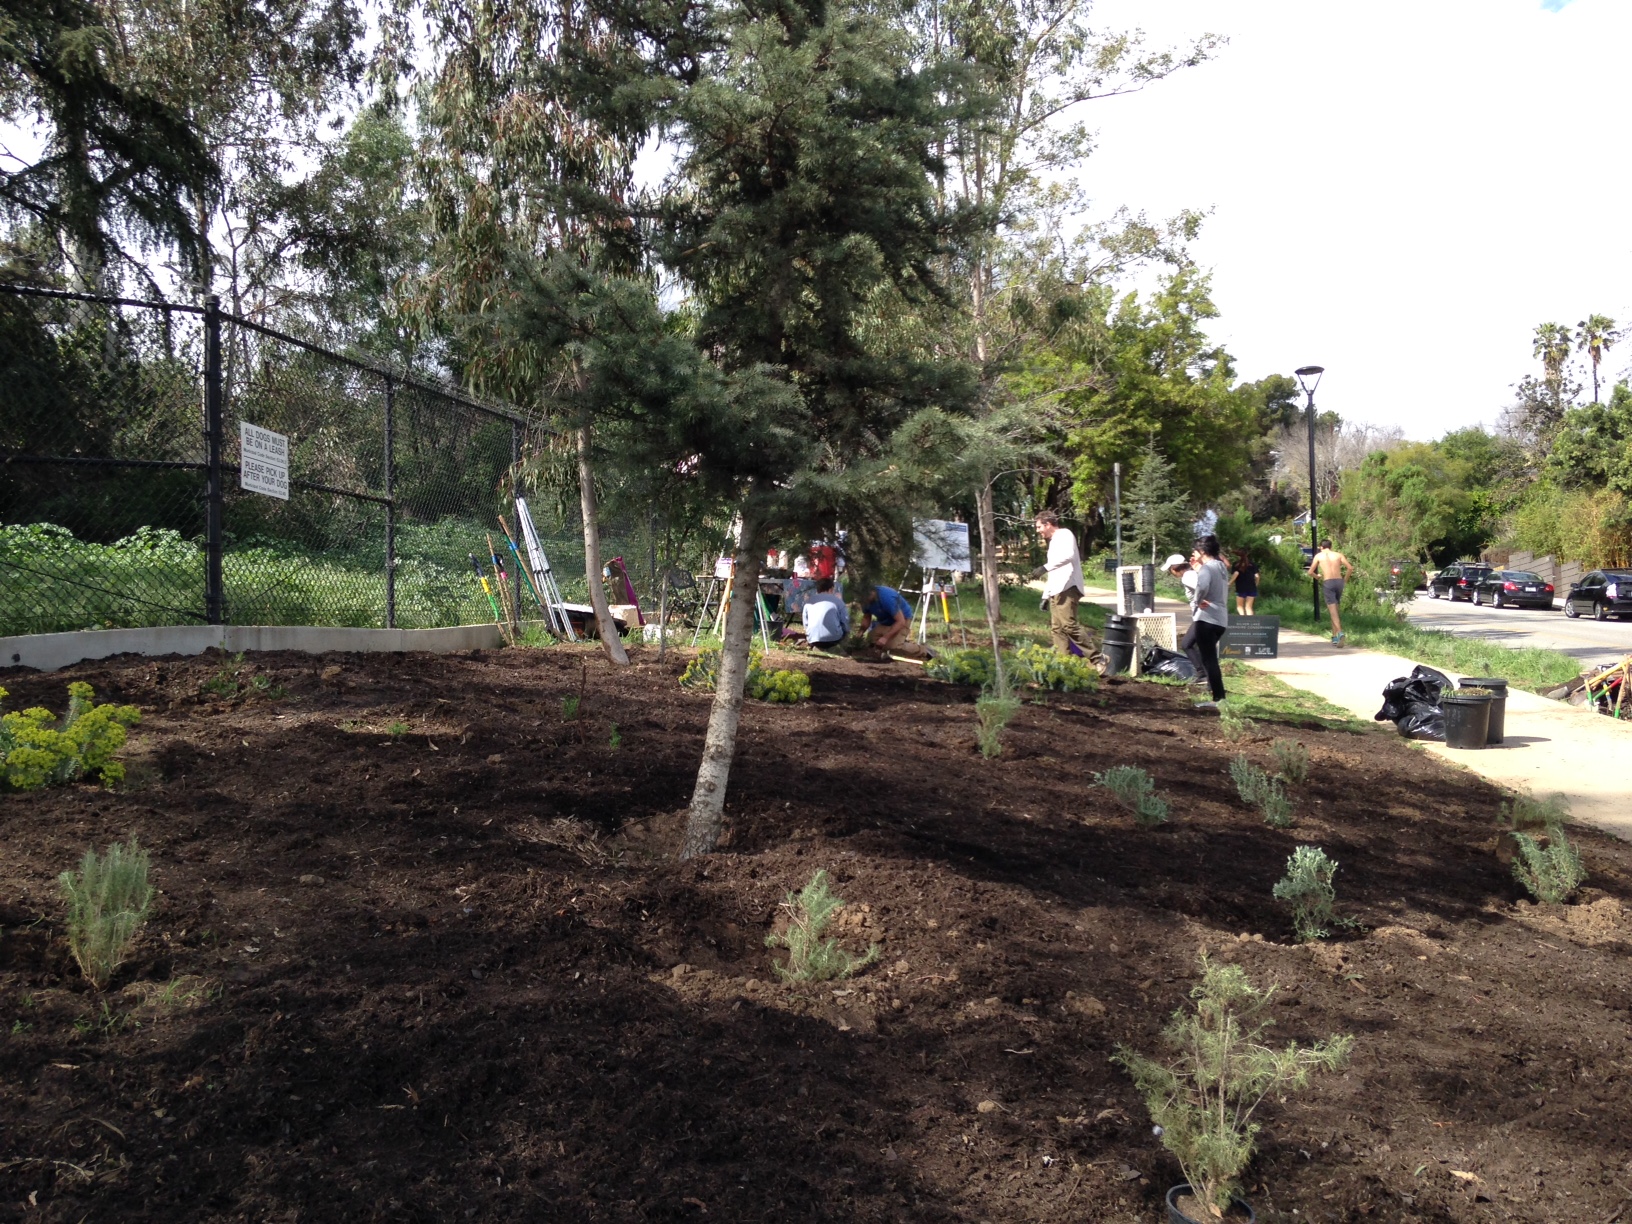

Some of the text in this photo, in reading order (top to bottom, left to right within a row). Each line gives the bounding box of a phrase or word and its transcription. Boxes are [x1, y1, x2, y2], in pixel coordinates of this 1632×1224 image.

[245, 428, 285, 447] ALL DOGS MUST
[246, 437, 253, 446] BE
[255, 440, 262, 449] ON
[269, 445, 284, 456] LEASH
[245, 461, 264, 473] PLEASE
[266, 467, 277, 477] PICK
[244, 471, 287, 489] AFTER YOUR DOG
